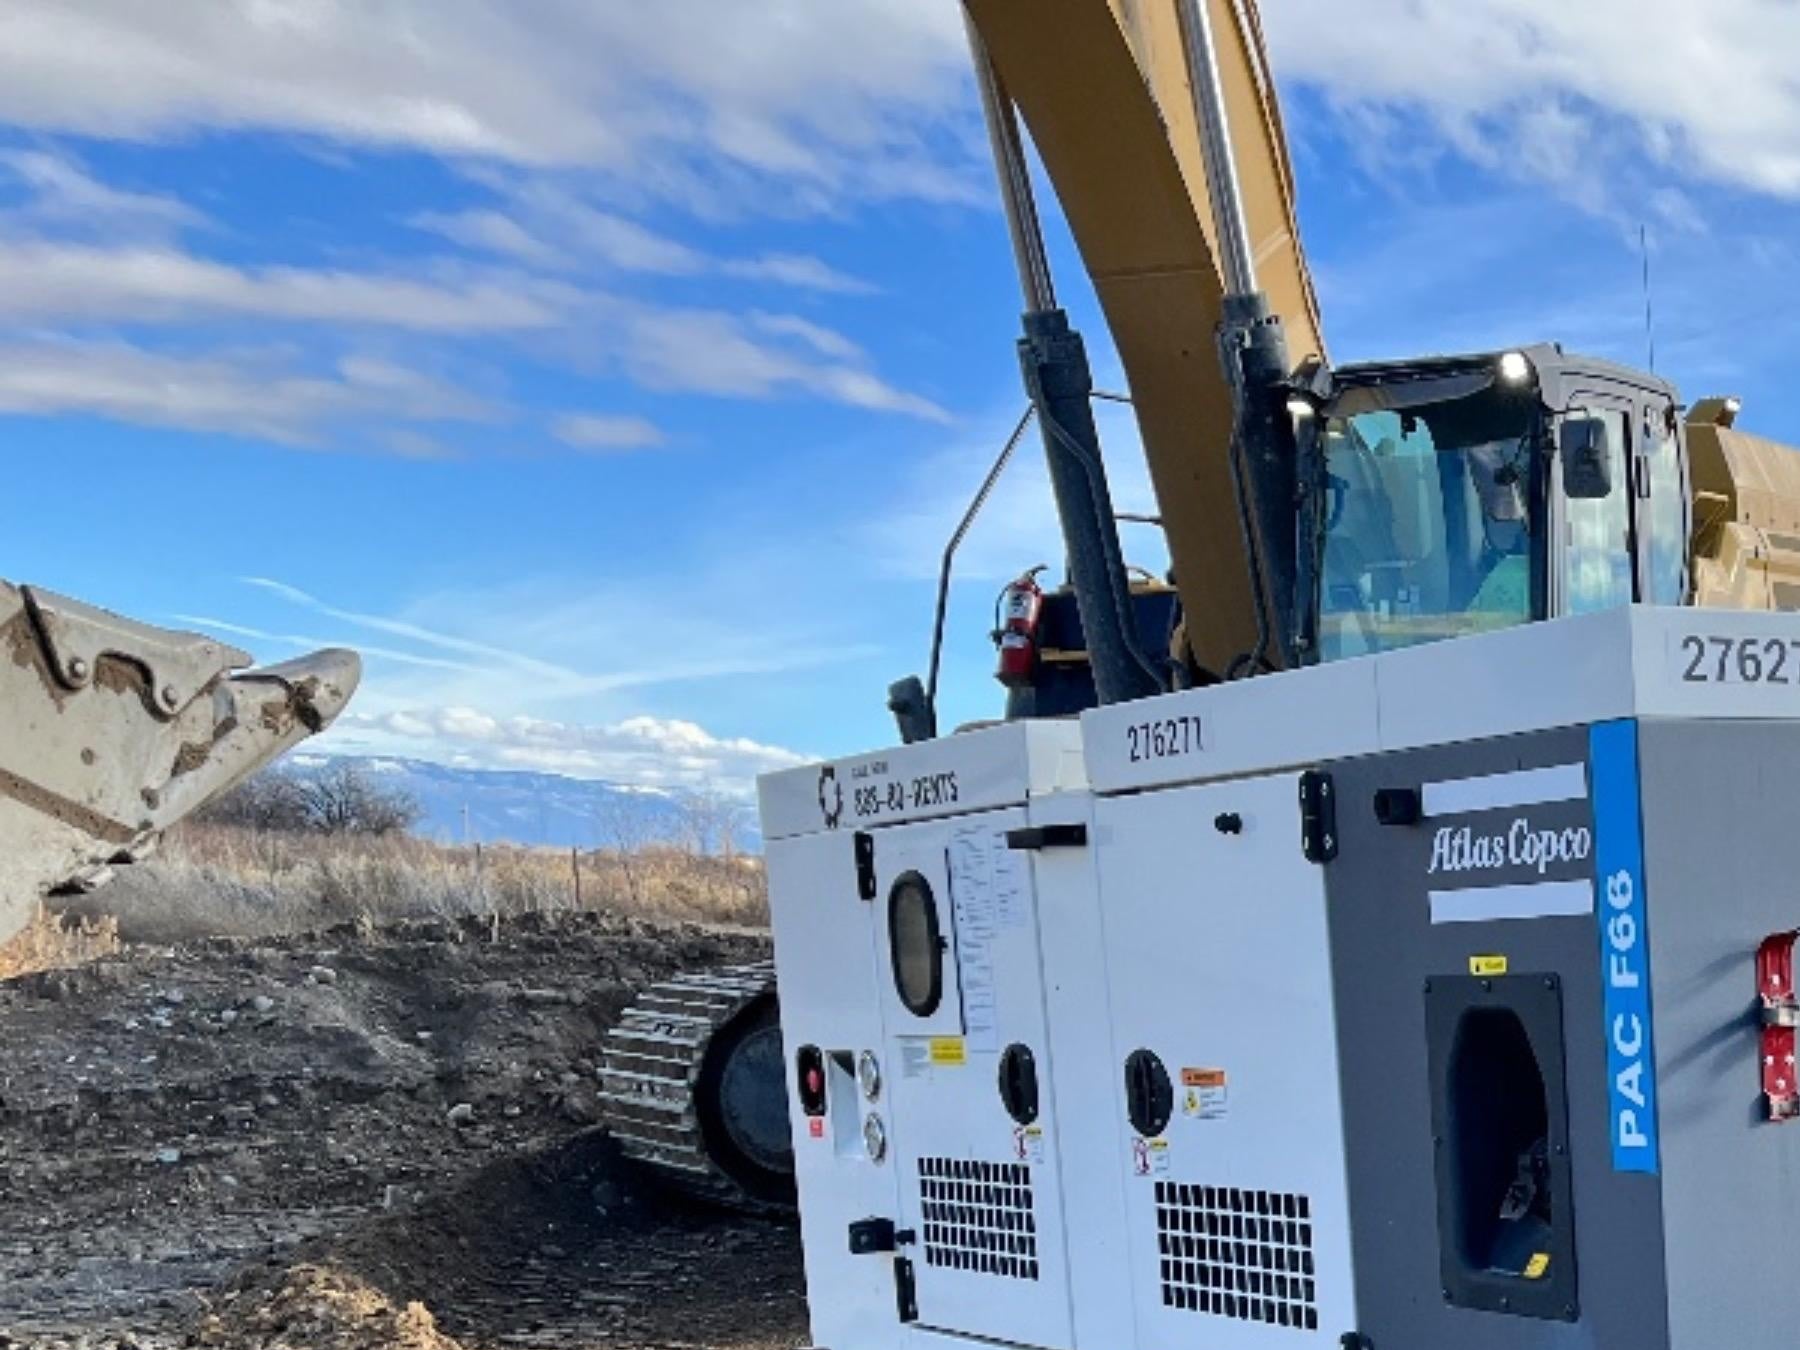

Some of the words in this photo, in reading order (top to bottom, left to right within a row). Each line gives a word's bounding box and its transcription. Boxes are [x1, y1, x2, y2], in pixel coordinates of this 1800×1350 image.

[1127, 715, 1203, 763] 276271
[1427, 826, 1505, 874] Atlas
[1508, 818, 1591, 874] Copco
[1606, 869, 1640, 988] F66
[1613, 1012, 1648, 1148] PAC
